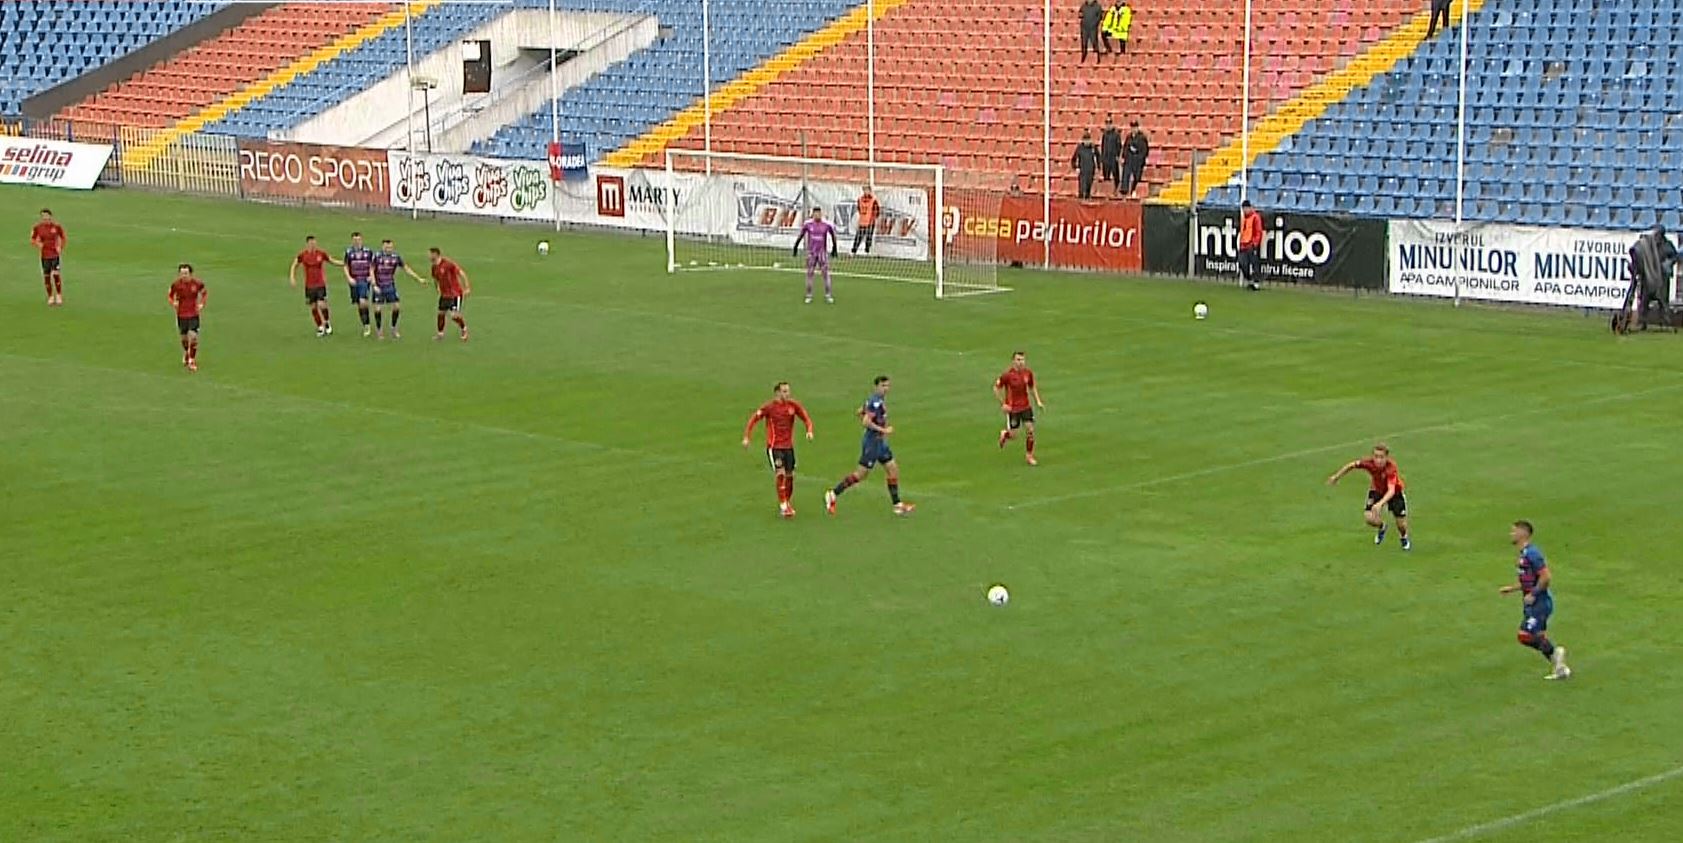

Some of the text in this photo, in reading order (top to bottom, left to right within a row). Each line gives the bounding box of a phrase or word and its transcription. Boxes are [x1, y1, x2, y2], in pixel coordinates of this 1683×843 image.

[2, 144, 73, 167] selina
[27, 165, 65, 182] grup
[239, 150, 388, 192] RECO SPORT
[629, 184, 681, 206] MARTY
[963, 216, 1136, 249] casa pariurilor
[1194, 216, 1331, 264] Intrioo
[1573, 239, 1629, 255] IZVORUL
[1399, 243, 1518, 278] MINUNILOR
[1534, 252, 1631, 281] MINUNIL
[1400, 272, 1520, 292] APA CAMPIONILOR
[1534, 281, 1561, 294] APA
